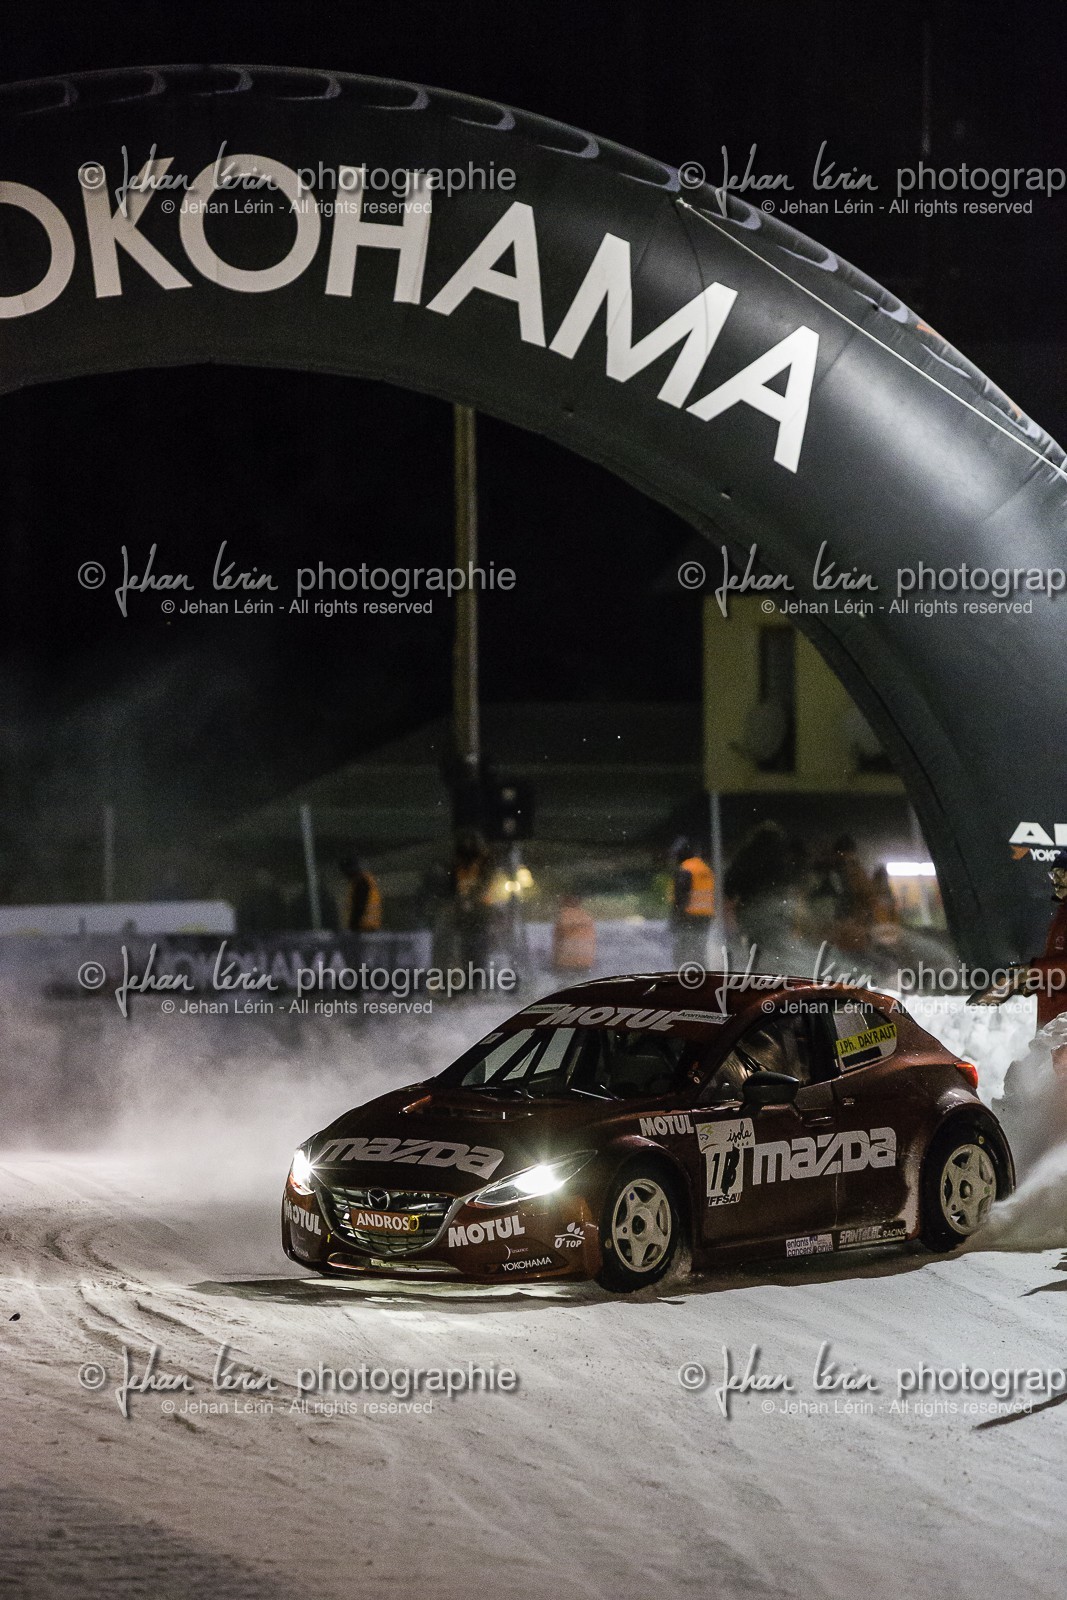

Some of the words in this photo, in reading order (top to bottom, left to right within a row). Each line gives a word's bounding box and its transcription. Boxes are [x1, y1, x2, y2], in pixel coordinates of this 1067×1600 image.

[536, 1005, 678, 1032] MOTUL
[857, 1025, 896, 1048] DAYRAUT
[638, 1114, 695, 1137] MOTUL
[709, 1193, 738, 1206] FFSA
[285, 1199, 322, 1236] MOTUL
[356, 1212, 411, 1231] ANDROS
[448, 1214, 526, 1248] MOTUL
[883, 1227, 907, 1238] RACING
[501, 1256, 553, 1271] YOKOHAMA
